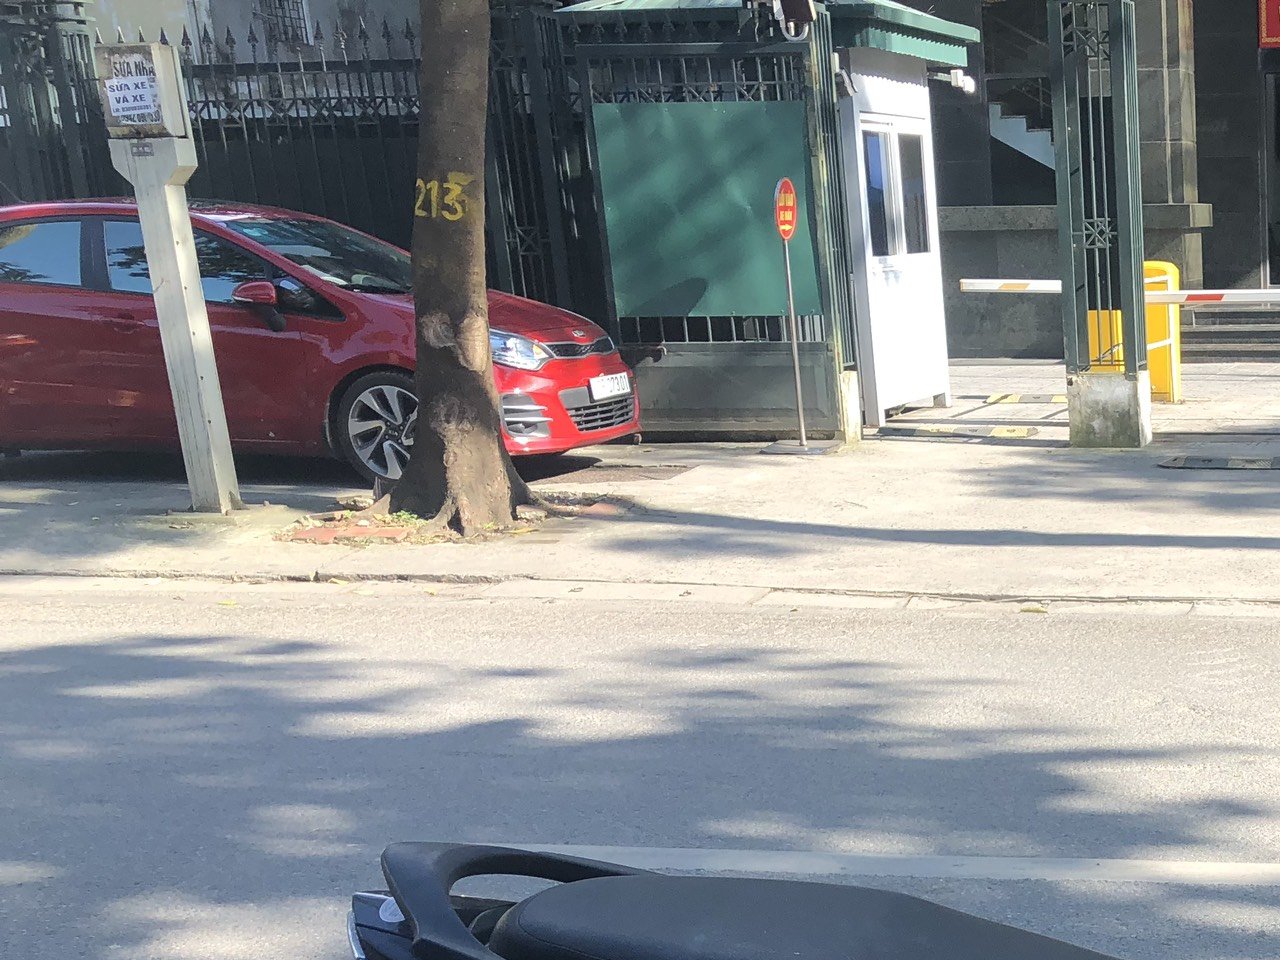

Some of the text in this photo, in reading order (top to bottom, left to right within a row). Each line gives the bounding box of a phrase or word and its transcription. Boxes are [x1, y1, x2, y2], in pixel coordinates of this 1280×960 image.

[133, 82, 147, 90] XE
[132, 94, 146, 102] XE
[415, 178, 463, 220] 213
